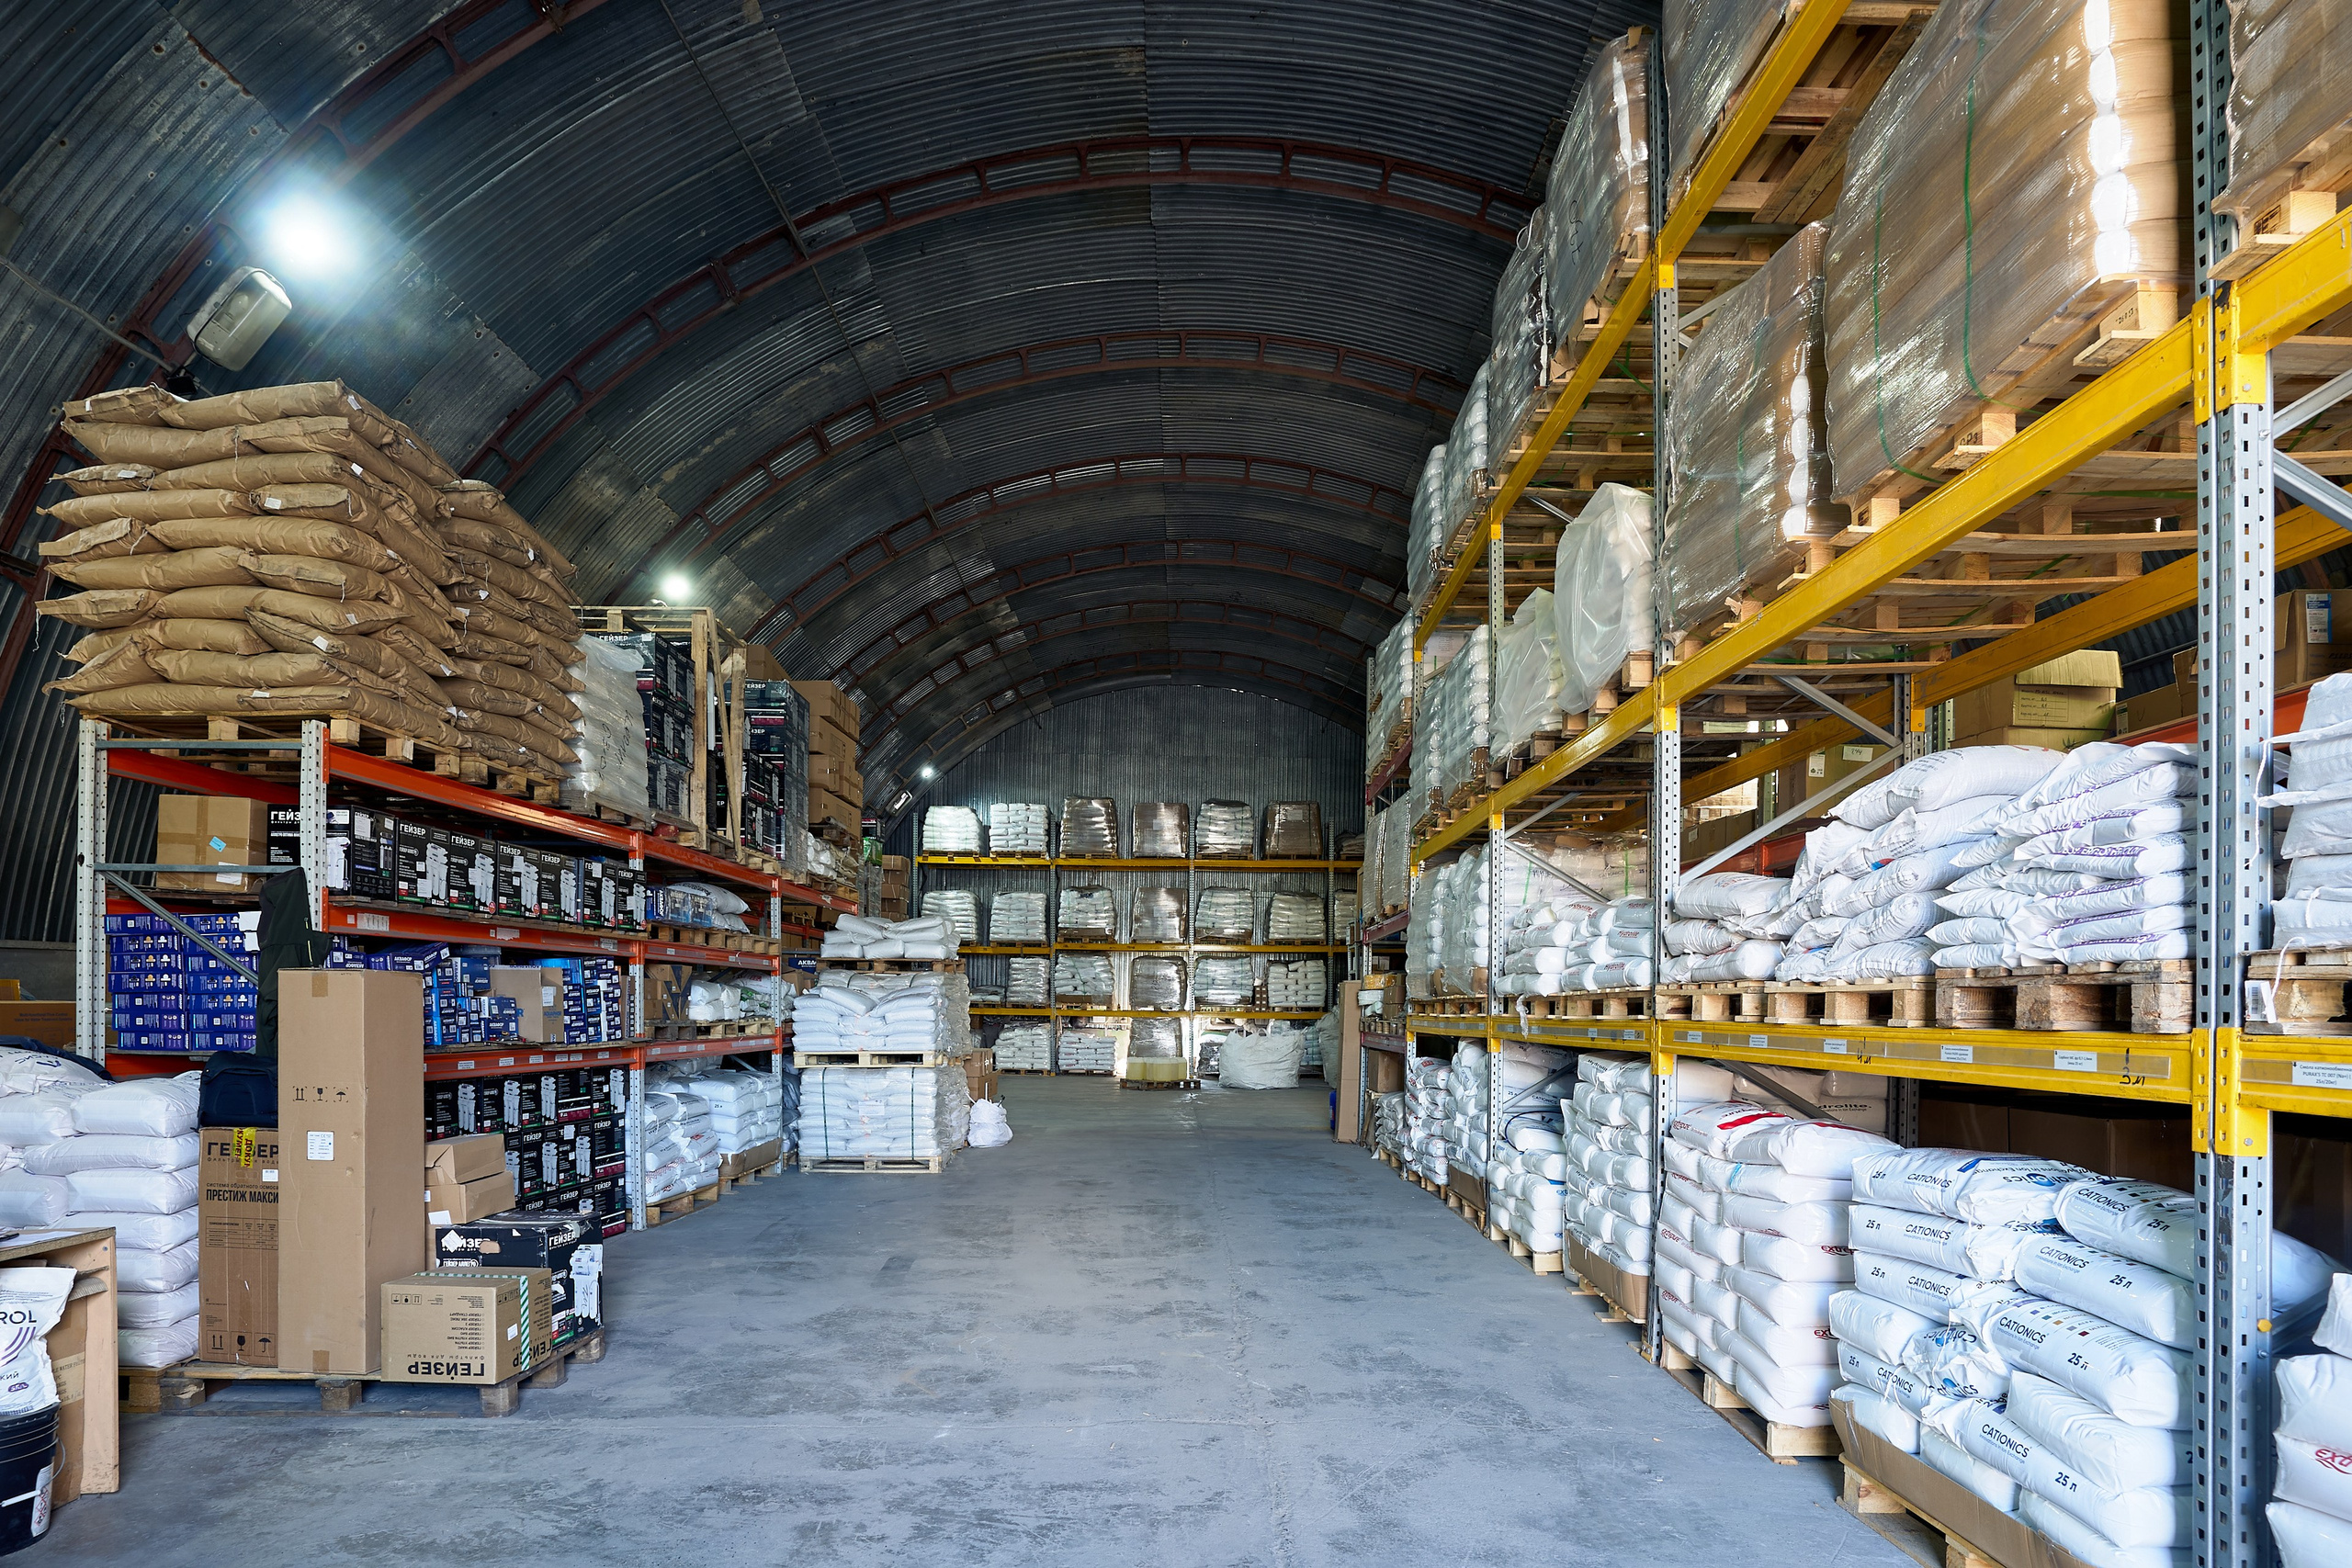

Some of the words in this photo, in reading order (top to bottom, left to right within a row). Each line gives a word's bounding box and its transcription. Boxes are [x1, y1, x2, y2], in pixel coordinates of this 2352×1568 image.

[270, 809, 300, 821] ГЕЙЗ
[399, 823, 426, 835] ГЕЙЗЕР
[451, 835, 476, 847] ГЕЙЗЕР
[500, 844, 522, 856] ГЕЙЗЕР
[1588, 1059, 1608, 1071] Hydrolit
[208, 1142, 278, 1158] ГЕЕР
[1907, 1173, 1952, 1189] CATIONICS
[206, 1189, 247, 1202] ПРЕСТИЖ
[2078, 1188, 2130, 1213] CATIONICS
[1866, 1220, 1876, 1229] 25
[2146, 1218, 2163, 1229] 25
[1905, 1224, 1951, 1240] CATIONICS
[548, 1231, 577, 1247] ГЕЙЗЕР
[1821, 1246, 1854, 1255] extrep
[2040, 1246, 2090, 1269] CATIONICS
[1871, 1267, 1880, 1276] 25
[1907, 1276, 1951, 1296] CATIONICS
[2109, 1275, 2125, 1286] 25
[1999, 1316, 2047, 1344] CATIONICS
[1849, 1356, 1856, 1366] 25
[2067, 1352, 2082, 1367] 25
[408, 1361, 485, 1381] ГЕЙЗЕР
[1981, 1424, 2030, 1459] CATIONICS
[2185, 1451, 2194, 1464] 2
[2054, 1472, 2070, 1486] 25
[2069, 1483, 2077, 1492] л
